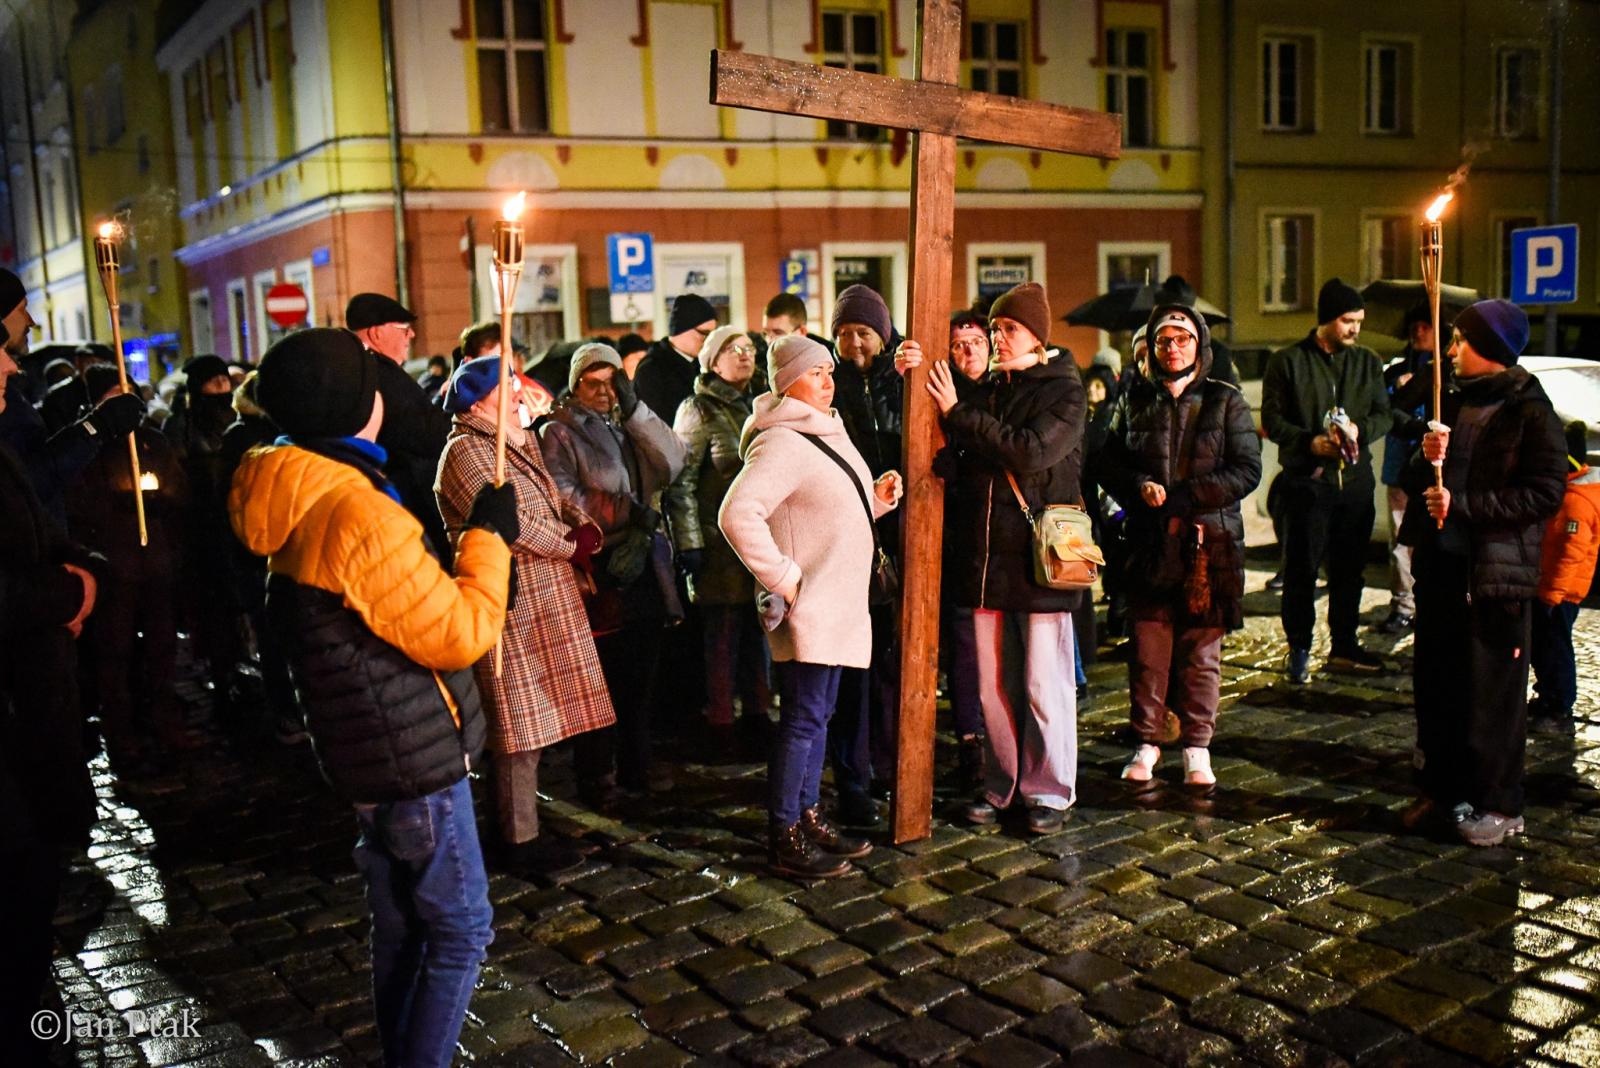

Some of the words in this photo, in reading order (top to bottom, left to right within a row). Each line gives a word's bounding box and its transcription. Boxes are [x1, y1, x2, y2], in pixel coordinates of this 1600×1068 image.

[617, 238, 645, 277] P
[786, 261, 803, 282] P
[1526, 235, 1563, 295] P
